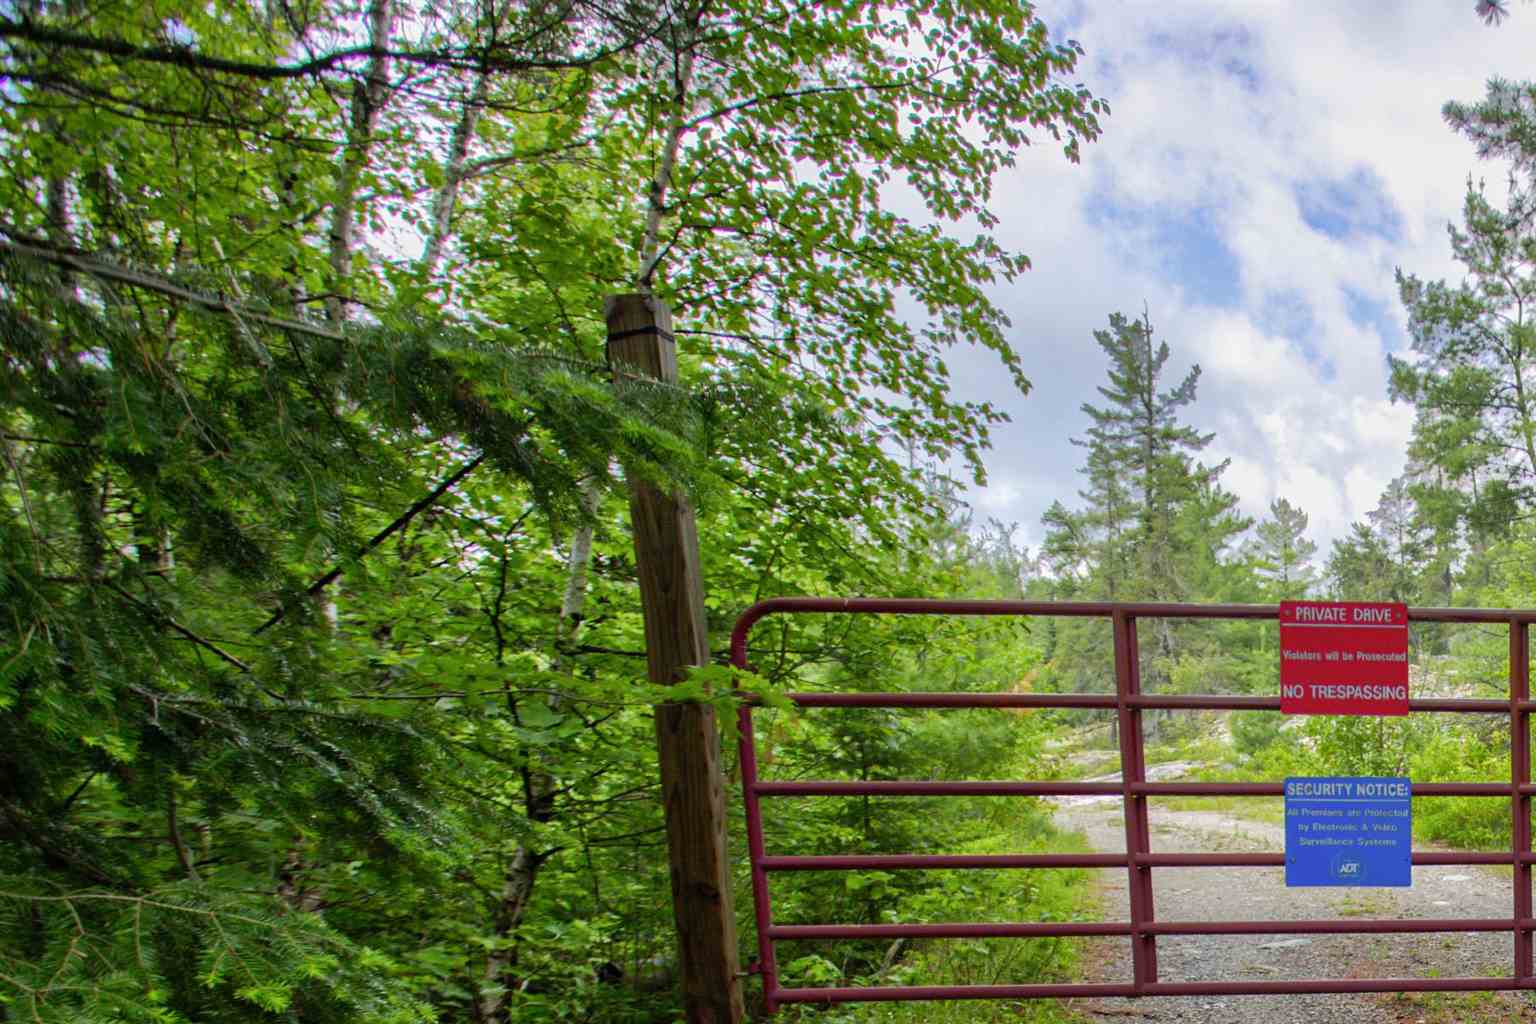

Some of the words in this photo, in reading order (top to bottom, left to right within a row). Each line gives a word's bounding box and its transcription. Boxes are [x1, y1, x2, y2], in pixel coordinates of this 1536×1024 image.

[1295, 607, 1346, 621] PRIVATE
[1353, 608, 1391, 622] DRIVE
[1283, 685, 1304, 698] NO
[1310, 685, 1406, 699] TRESPASSING
[1287, 783, 1352, 796] SECURITY
[1356, 783, 1408, 796] NOTICE:
[1340, 863, 1360, 873] ADT
